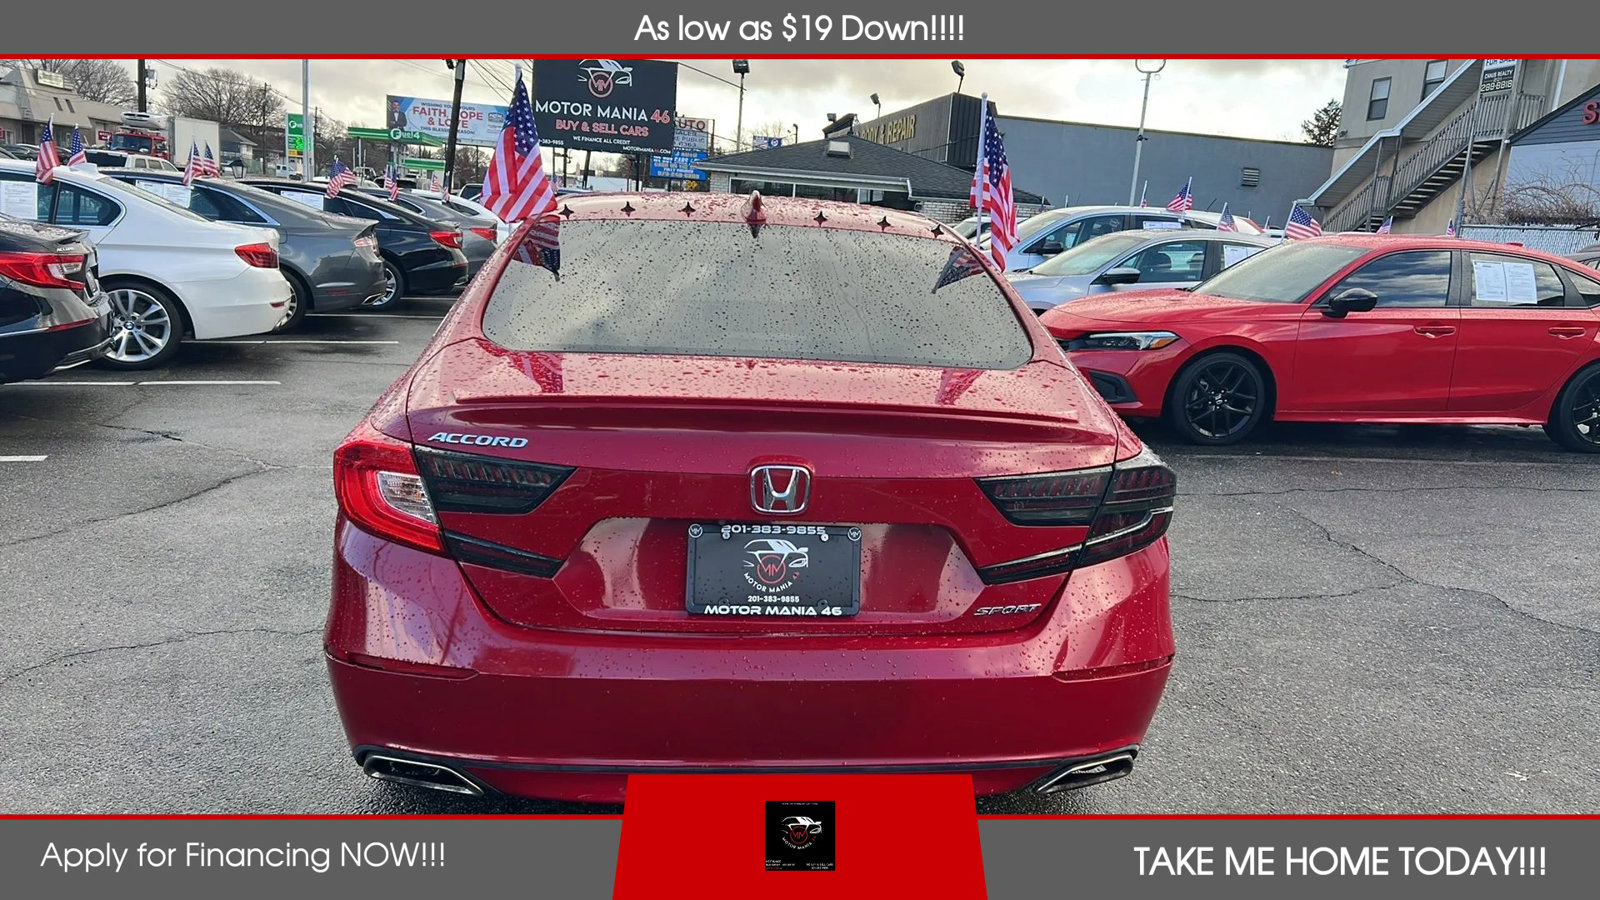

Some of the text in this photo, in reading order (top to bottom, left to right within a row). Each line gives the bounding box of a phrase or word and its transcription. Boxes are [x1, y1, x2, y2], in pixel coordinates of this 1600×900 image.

[412, 106, 449, 118] FAITH,
[460, 110, 484, 121] OPE
[535, 100, 671, 124] MOTOR MANIA 46
[427, 116, 469, 129] & LOE
[555, 119, 649, 137] BUY & SELL CARS
[678, 118, 706, 130] UTO
[886, 114, 917, 144] REPAIR
[428, 432, 529, 448] ACCORD
[721, 525, 826, 535] 201-383-9855
[743, 572, 767, 593] MOTOR
[768, 580, 793, 593] MANIA
[747, 595, 800, 603] 201-383-9855
[704, 605, 843, 616] MOTOR MANIA 46
[973, 603, 1042, 616] SPORT
